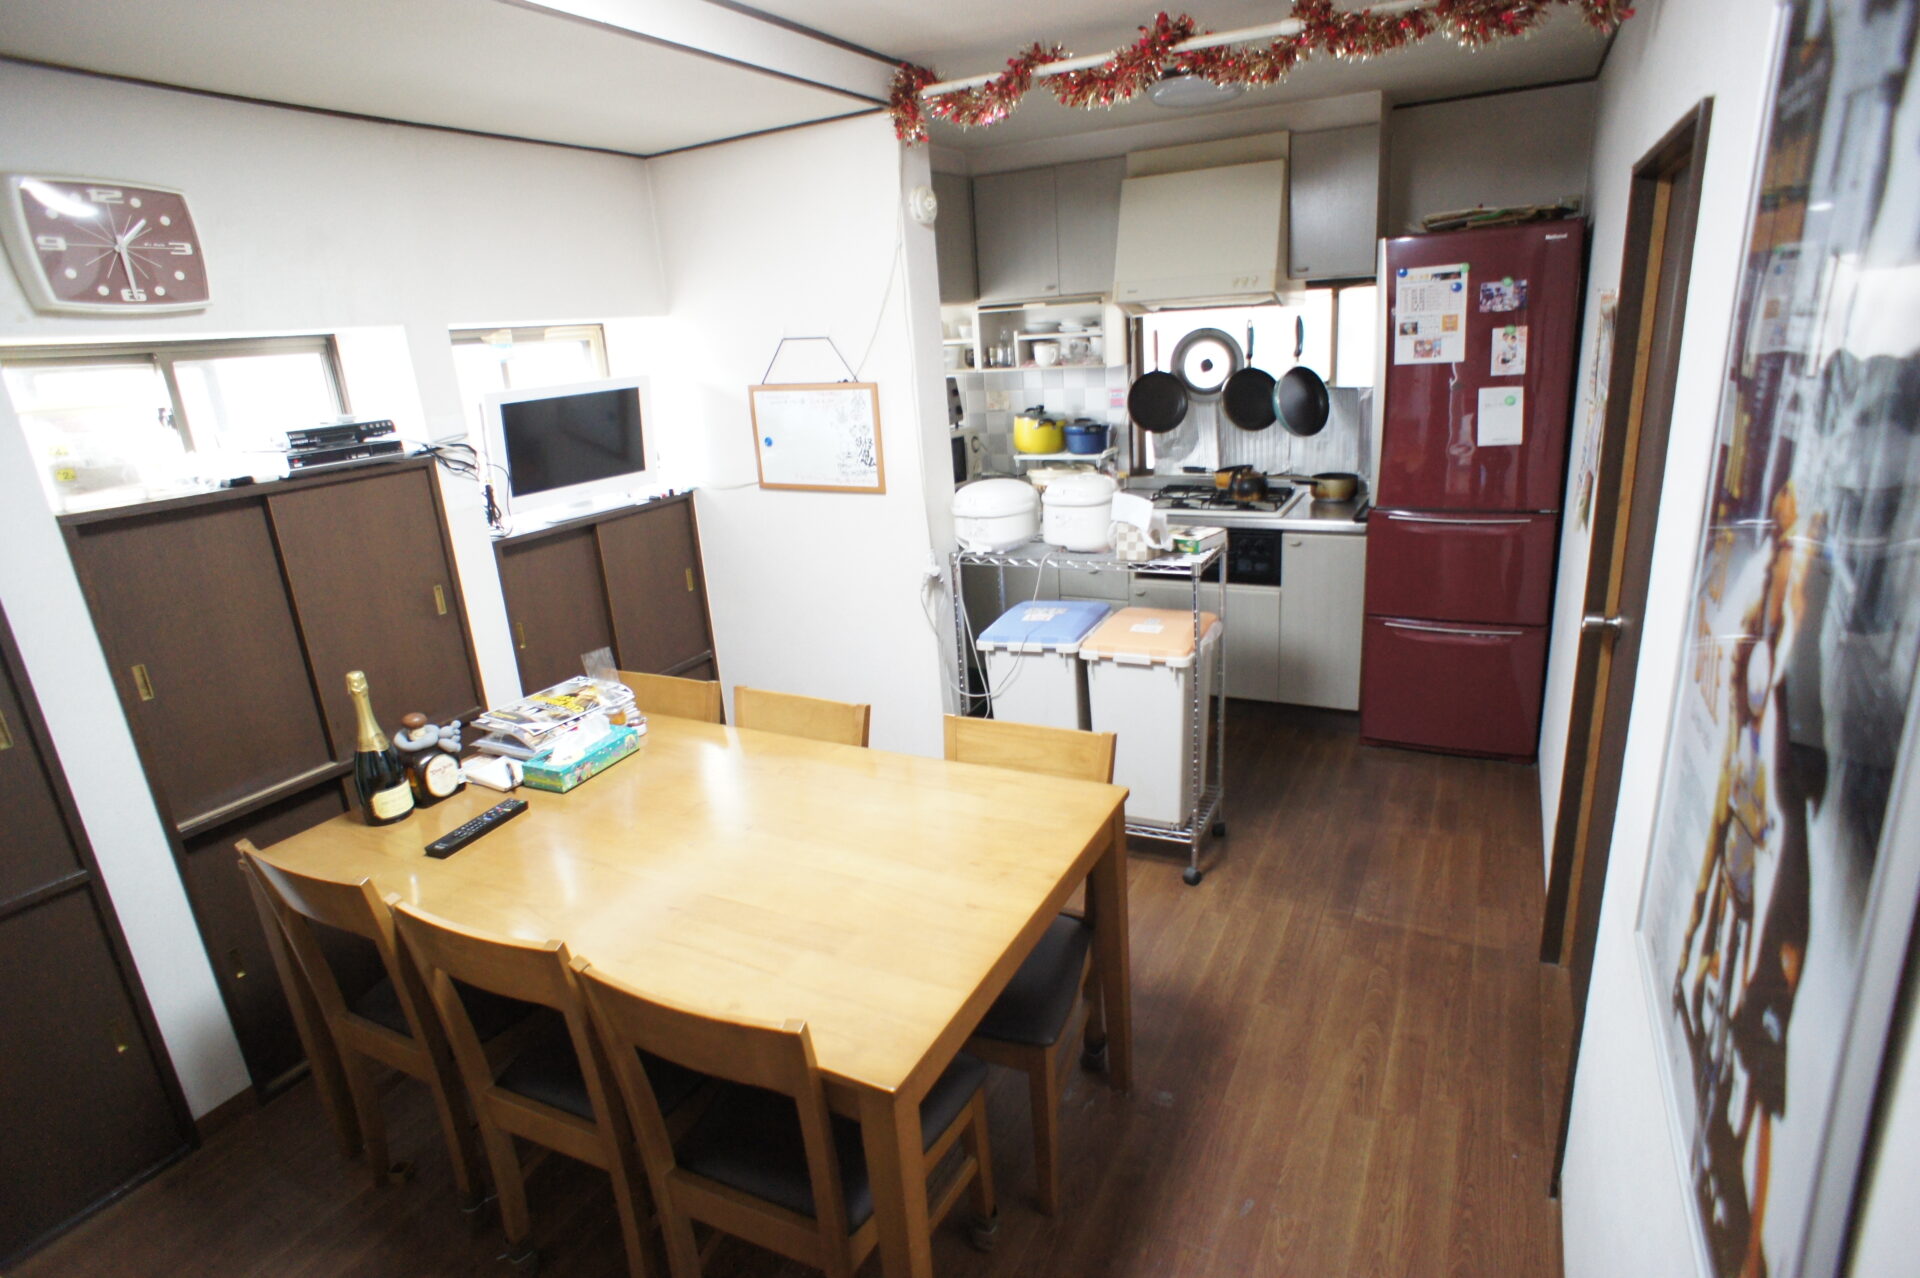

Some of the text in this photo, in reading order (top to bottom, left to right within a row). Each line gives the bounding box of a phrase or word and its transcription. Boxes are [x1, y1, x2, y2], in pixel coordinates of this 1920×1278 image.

[86, 188, 124, 205] 12
[36, 235, 67, 251] 9
[168, 241, 193, 256] 3
[120, 288, 147, 302] 6
